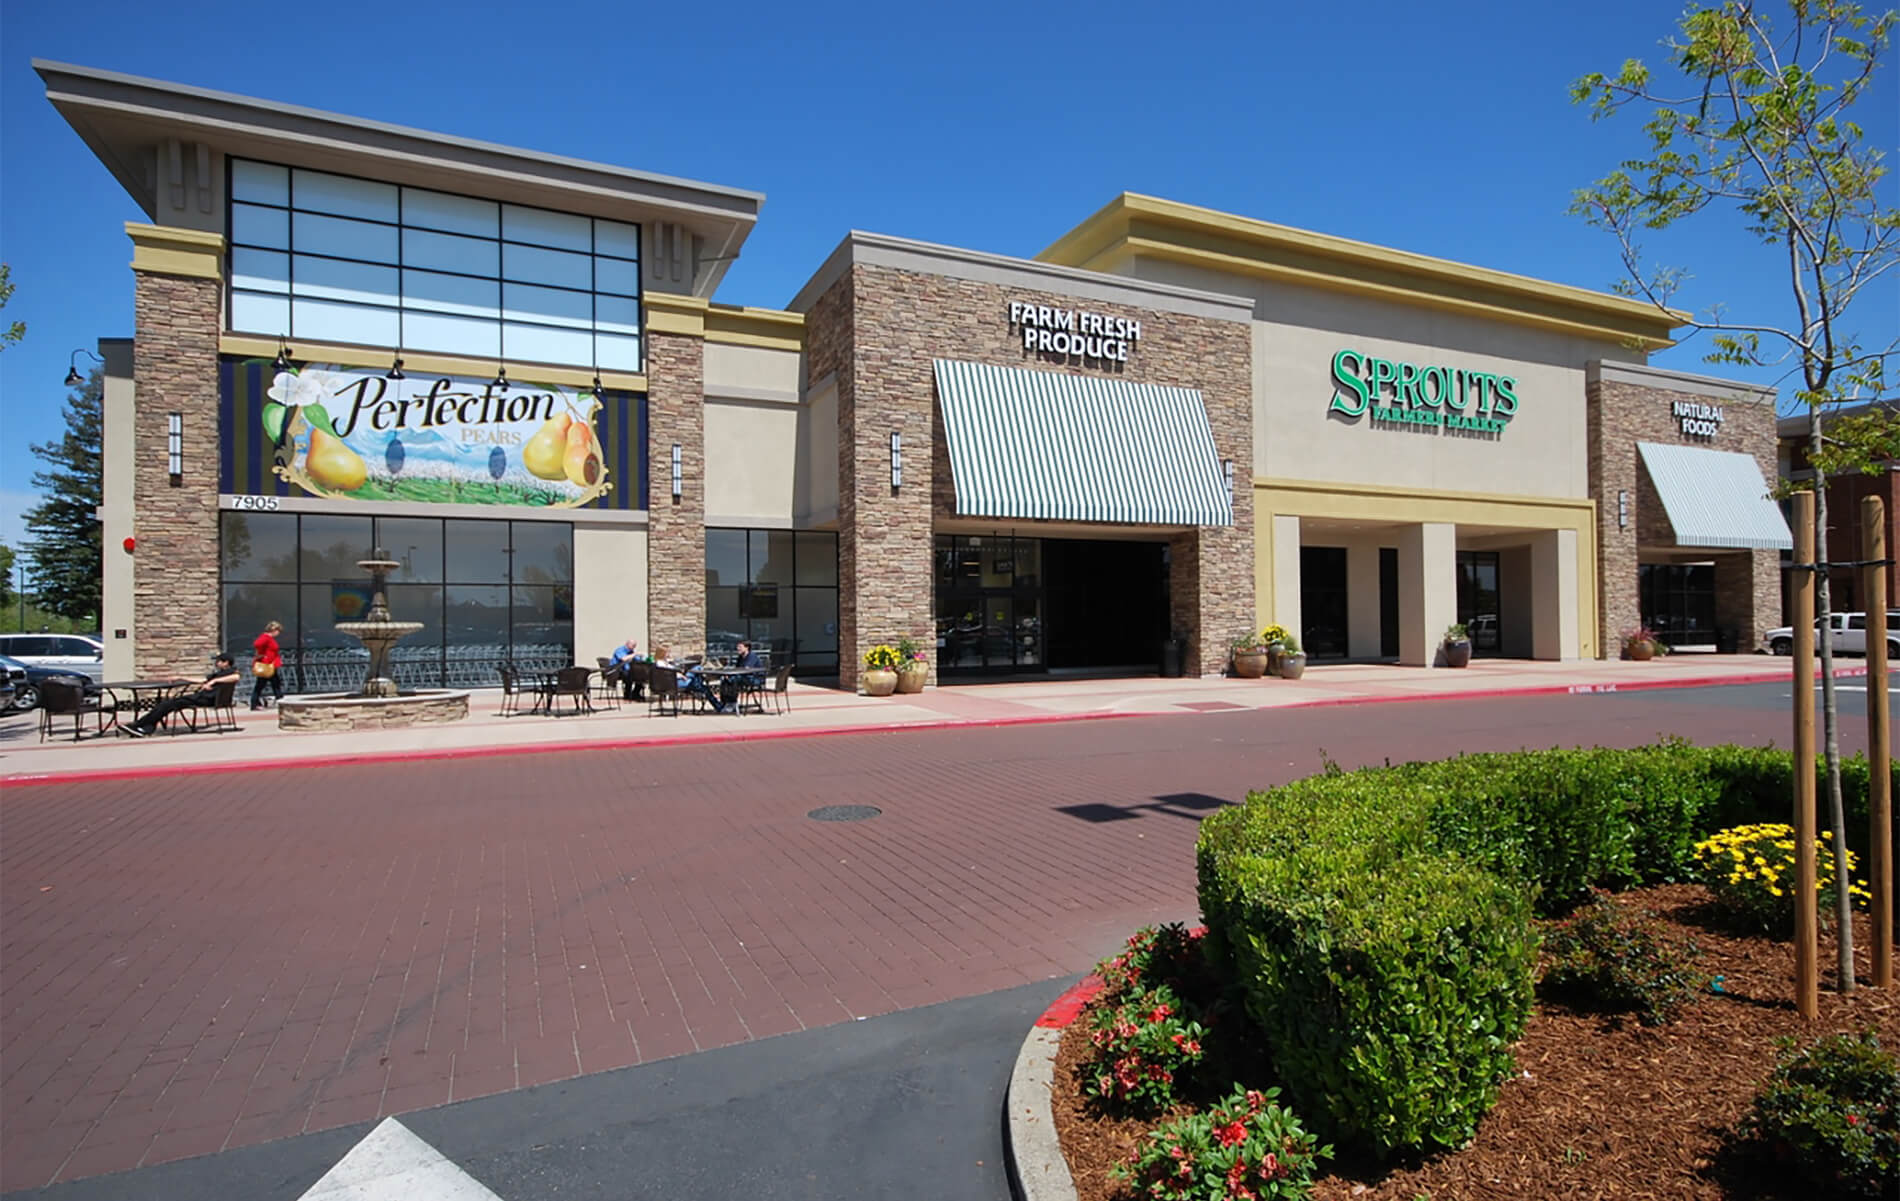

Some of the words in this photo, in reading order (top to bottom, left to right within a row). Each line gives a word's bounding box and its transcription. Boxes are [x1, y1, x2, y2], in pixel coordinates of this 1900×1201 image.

[1011, 302, 1073, 331] FARM
[1080, 312, 1140, 340] FRESH
[1025, 328, 1128, 361] PRODUCE
[1332, 349, 1519, 416] SPROUTS
[332, 376, 554, 438] Perfection
[1372, 405, 1443, 426] FARMERS
[1447, 413, 1506, 432] MARKET
[1674, 401, 1724, 421] NATURAL
[461, 428, 521, 445] PEARS
[1682, 418, 1717, 436] FOODS
[232, 495, 278, 510] 7905
